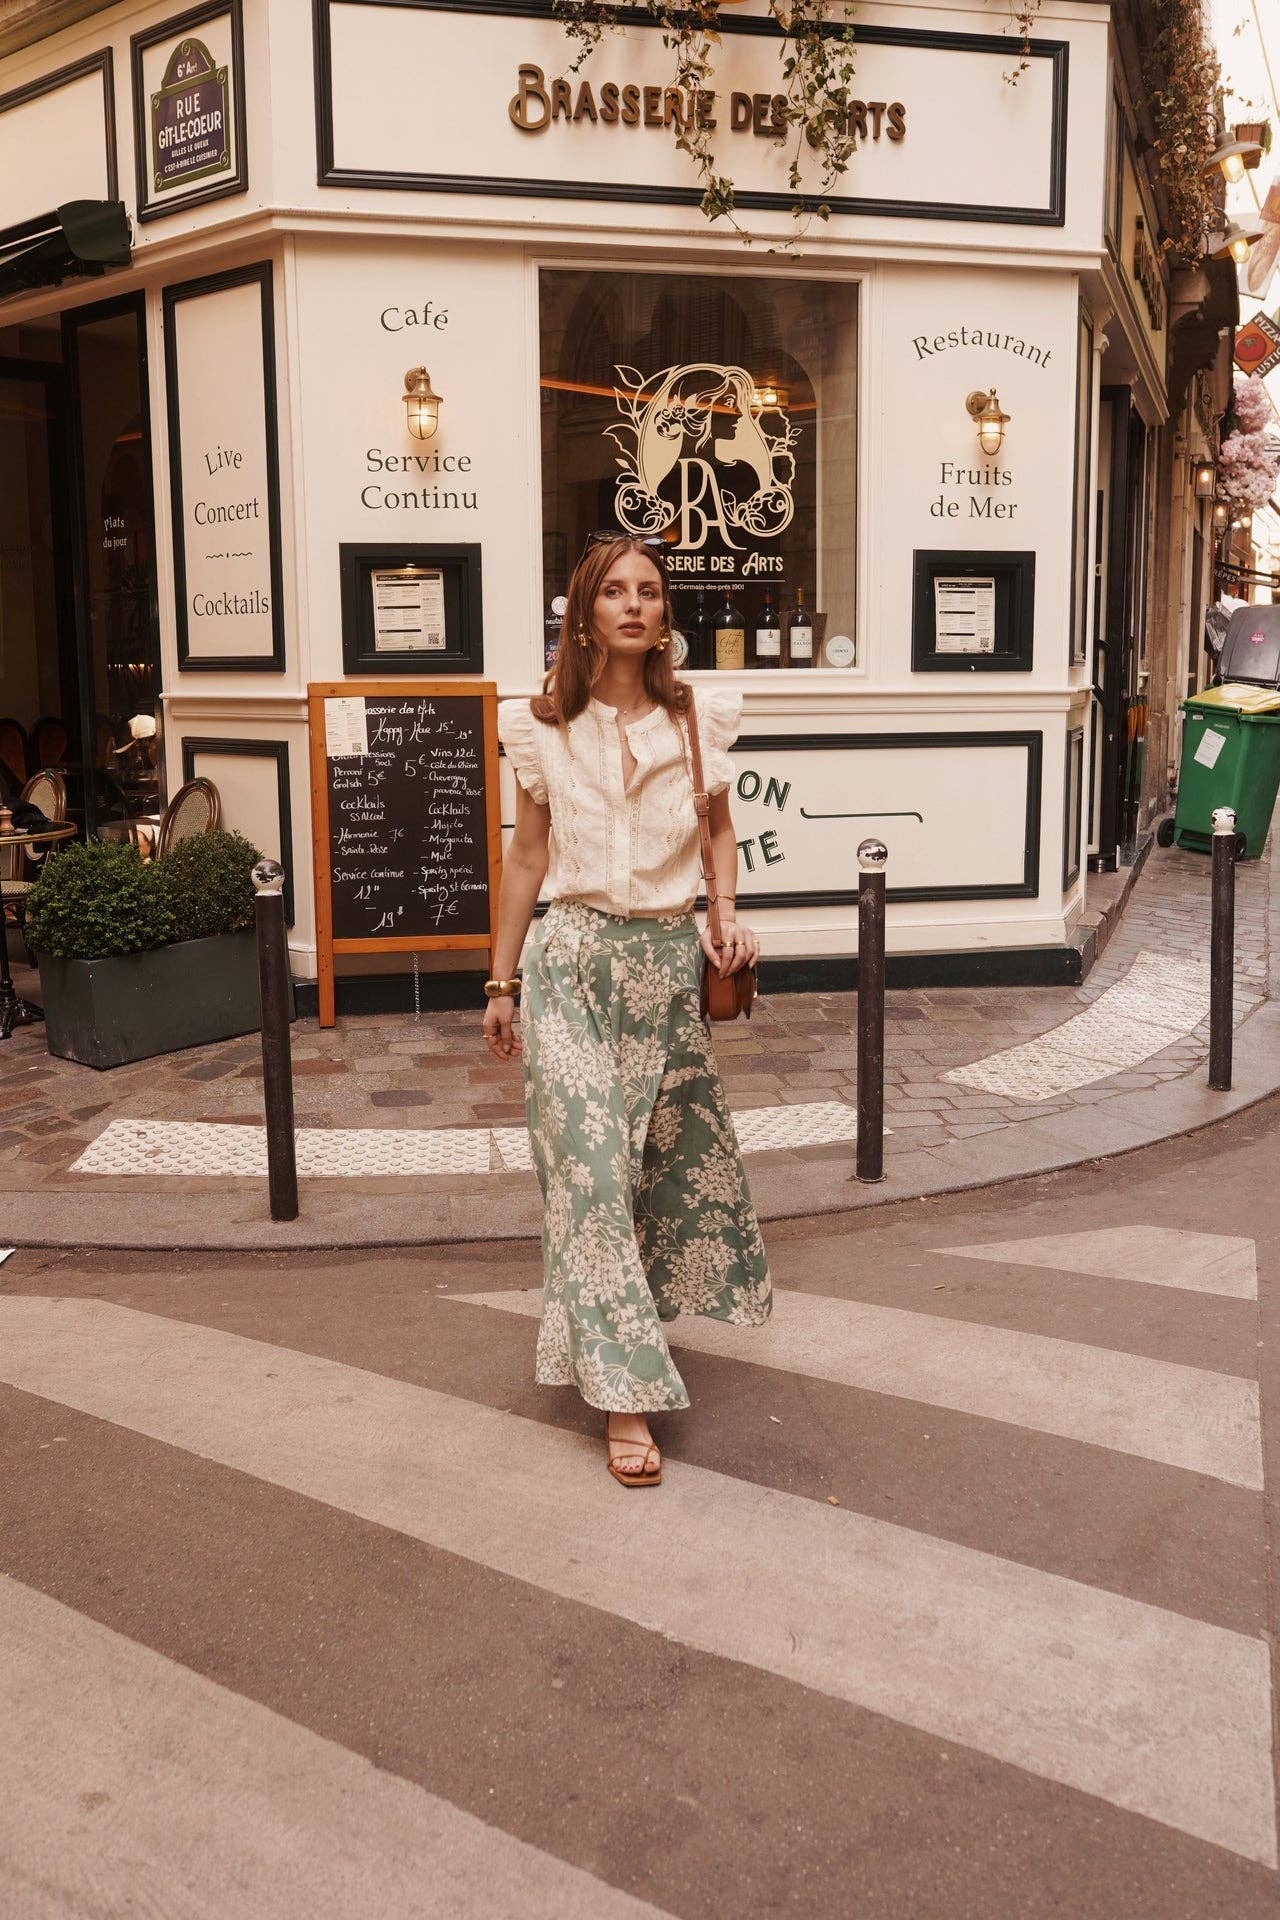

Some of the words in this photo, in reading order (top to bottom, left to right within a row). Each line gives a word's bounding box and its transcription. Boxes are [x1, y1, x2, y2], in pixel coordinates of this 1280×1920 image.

[176, 92, 200, 120] RUE
[508, 63, 717, 131] BRASSERIE
[730, 91, 788, 136] DES
[380, 302, 449, 332] Café
[912, 326, 1052, 369] Restaurant
[204, 446, 243, 476] Live
[367, 448, 471, 473] Service
[939, 463, 1012, 486] Fruits
[195, 497, 259, 526] Concert
[361, 486, 478, 510] Continu
[930, 496, 959, 518] de
[969, 496, 1018, 520] Mer
[104, 516, 124, 532] Plats
[103, 537, 112, 548] du
[710, 556, 734, 572] DES
[742, 552, 783, 576] ARTS
[193, 591, 269, 617] Cocktails
[737, 770, 791, 812] ON
[736, 830, 785, 873] TE
